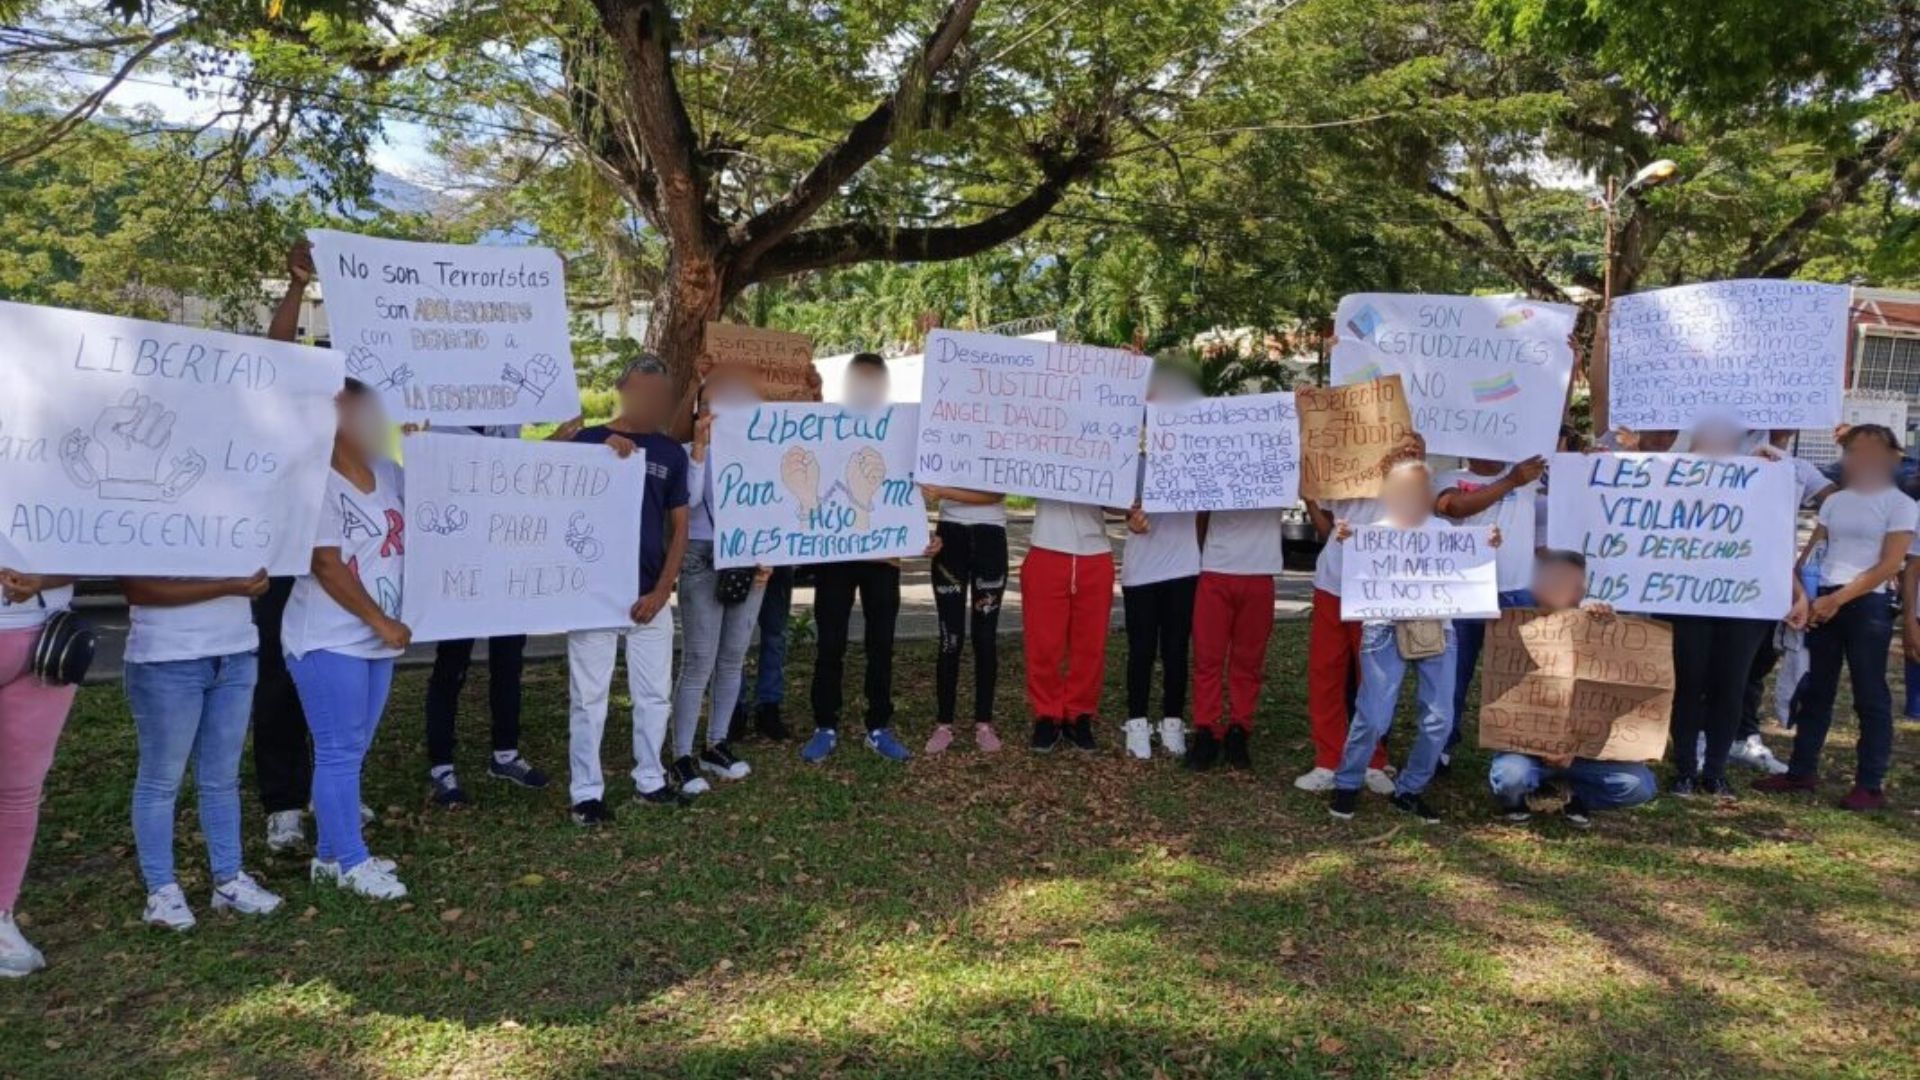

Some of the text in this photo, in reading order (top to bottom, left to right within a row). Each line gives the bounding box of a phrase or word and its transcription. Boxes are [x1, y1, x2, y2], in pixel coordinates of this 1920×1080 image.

[339, 254, 550, 288] No son Terroristas
[376, 296, 409, 320] Son
[1419, 305, 1464, 329] SON
[361, 328, 392, 346] con
[410, 327, 490, 351] DERECHO
[1378, 332, 1549, 365] ESTUDIANTES
[74, 333, 276, 389] LIBERTAD
[936, 337, 1148, 380] Deseamos LIBERTAD
[404, 384, 518, 411] LA LIBERTAD
[966, 367, 1081, 401] JUSTICIA
[1411, 372, 1446, 399] NO
[747, 407, 895, 445] Libertad
[930, 399, 1138, 443] ANGEL DAVID ya que
[0, 434, 47, 464] ara
[921, 429, 942, 444] es
[950, 432, 972, 446] un
[986, 430, 1112, 461] DEPORTISTA
[1152, 431, 1177, 451] NO
[1179, 431, 1243, 451] tienen
[1215, 450, 1250, 465] con
[1305, 453, 1331, 482] NO
[1588, 457, 1759, 489] LES ESTAN
[449, 460, 611, 497] LIBERTAD
[718, 462, 783, 510] Para
[882, 472, 914, 506] mi
[920, 454, 1115, 500] NO un TERRORISTA
[1156, 478, 1179, 490] en
[10, 503, 272, 548] ADOLESCENTES
[488, 512, 548, 543] PARA
[1600, 494, 1744, 534] VIOLANDO
[720, 525, 908, 558] NO ES TERRORISTA
[1355, 528, 1476, 556] LIBERTAD PARA
[1582, 531, 1752, 560] LOS DERECHOS
[442, 565, 586, 599] MI HIJO
[1372, 555, 1397, 577] MI
[1391, 582, 1421, 601] NO
[1432, 583, 1454, 605] ES
[1585, 571, 1761, 604] LOS ESTUDIOS
